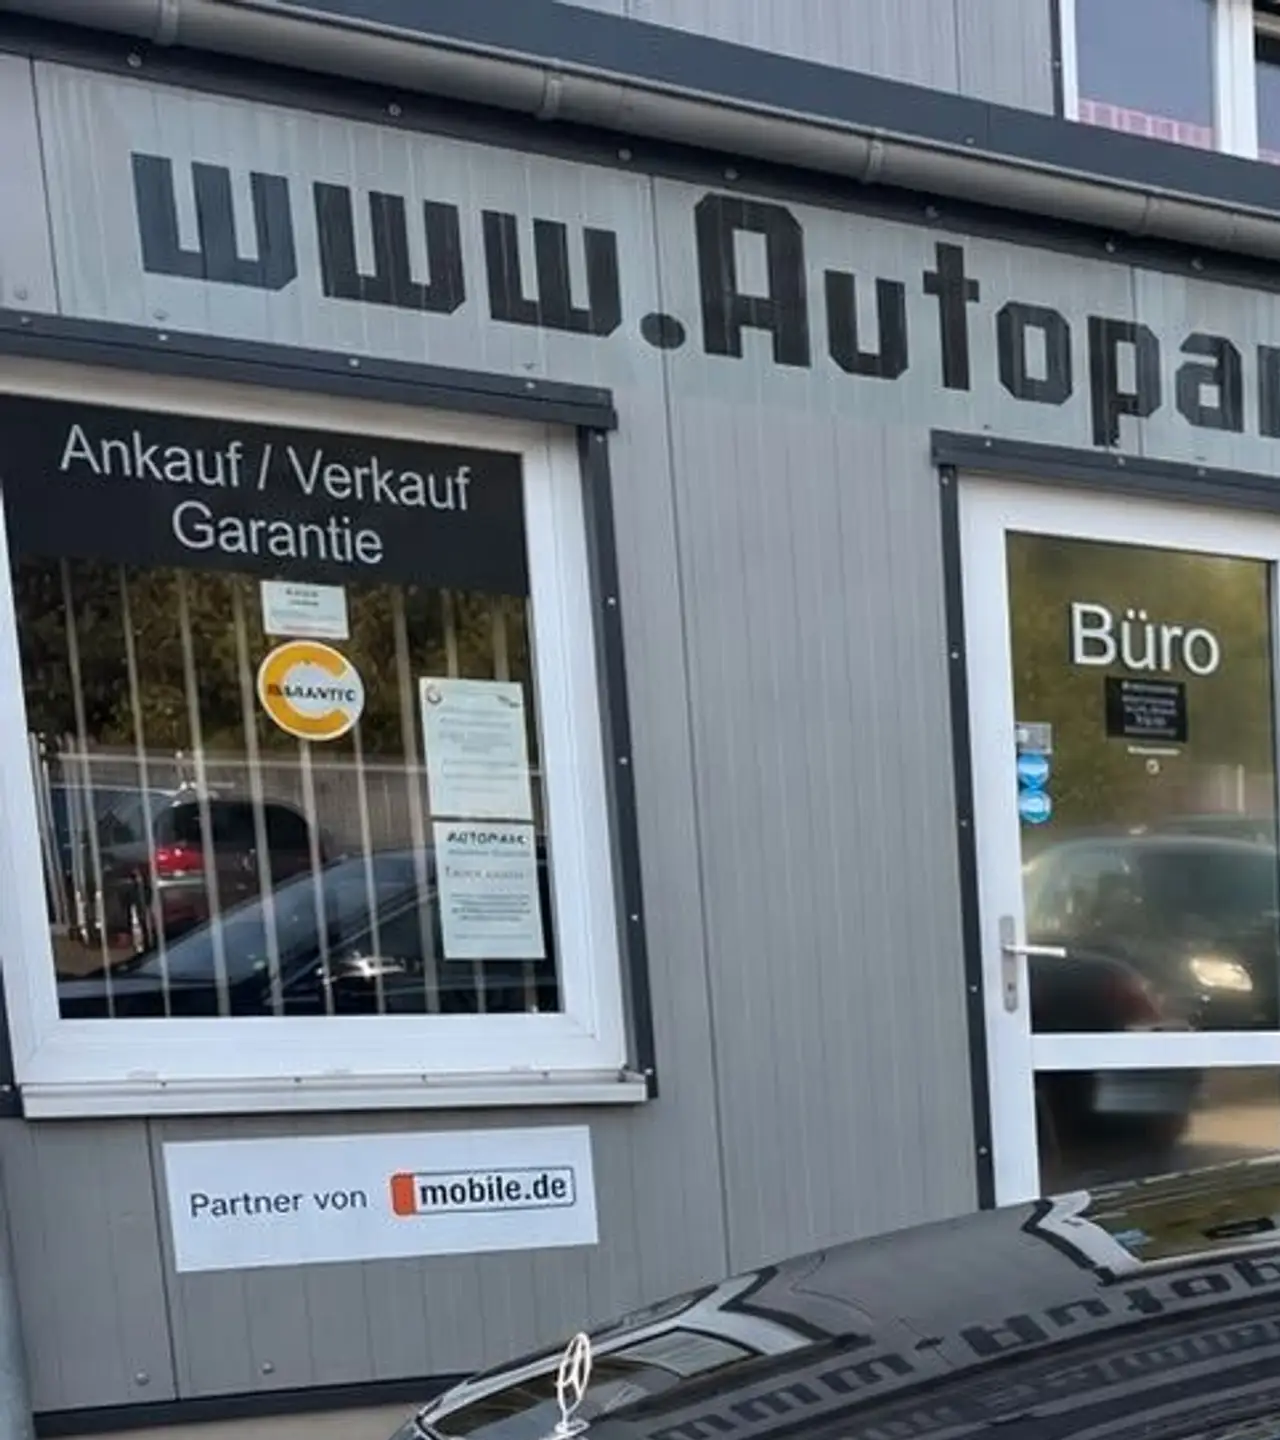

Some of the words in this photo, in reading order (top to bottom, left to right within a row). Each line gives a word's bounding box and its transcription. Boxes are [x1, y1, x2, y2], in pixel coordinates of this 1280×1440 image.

[58, 423, 243, 489] Ankauf
[286, 446, 472, 512] Verkauf
[172, 500, 384, 564] Garantie
[1070, 602, 1220, 675] Büro
[190, 1190, 302, 1219] Partner
[313, 1189, 368, 1211] von
[420, 1173, 567, 1206] mobile.de
